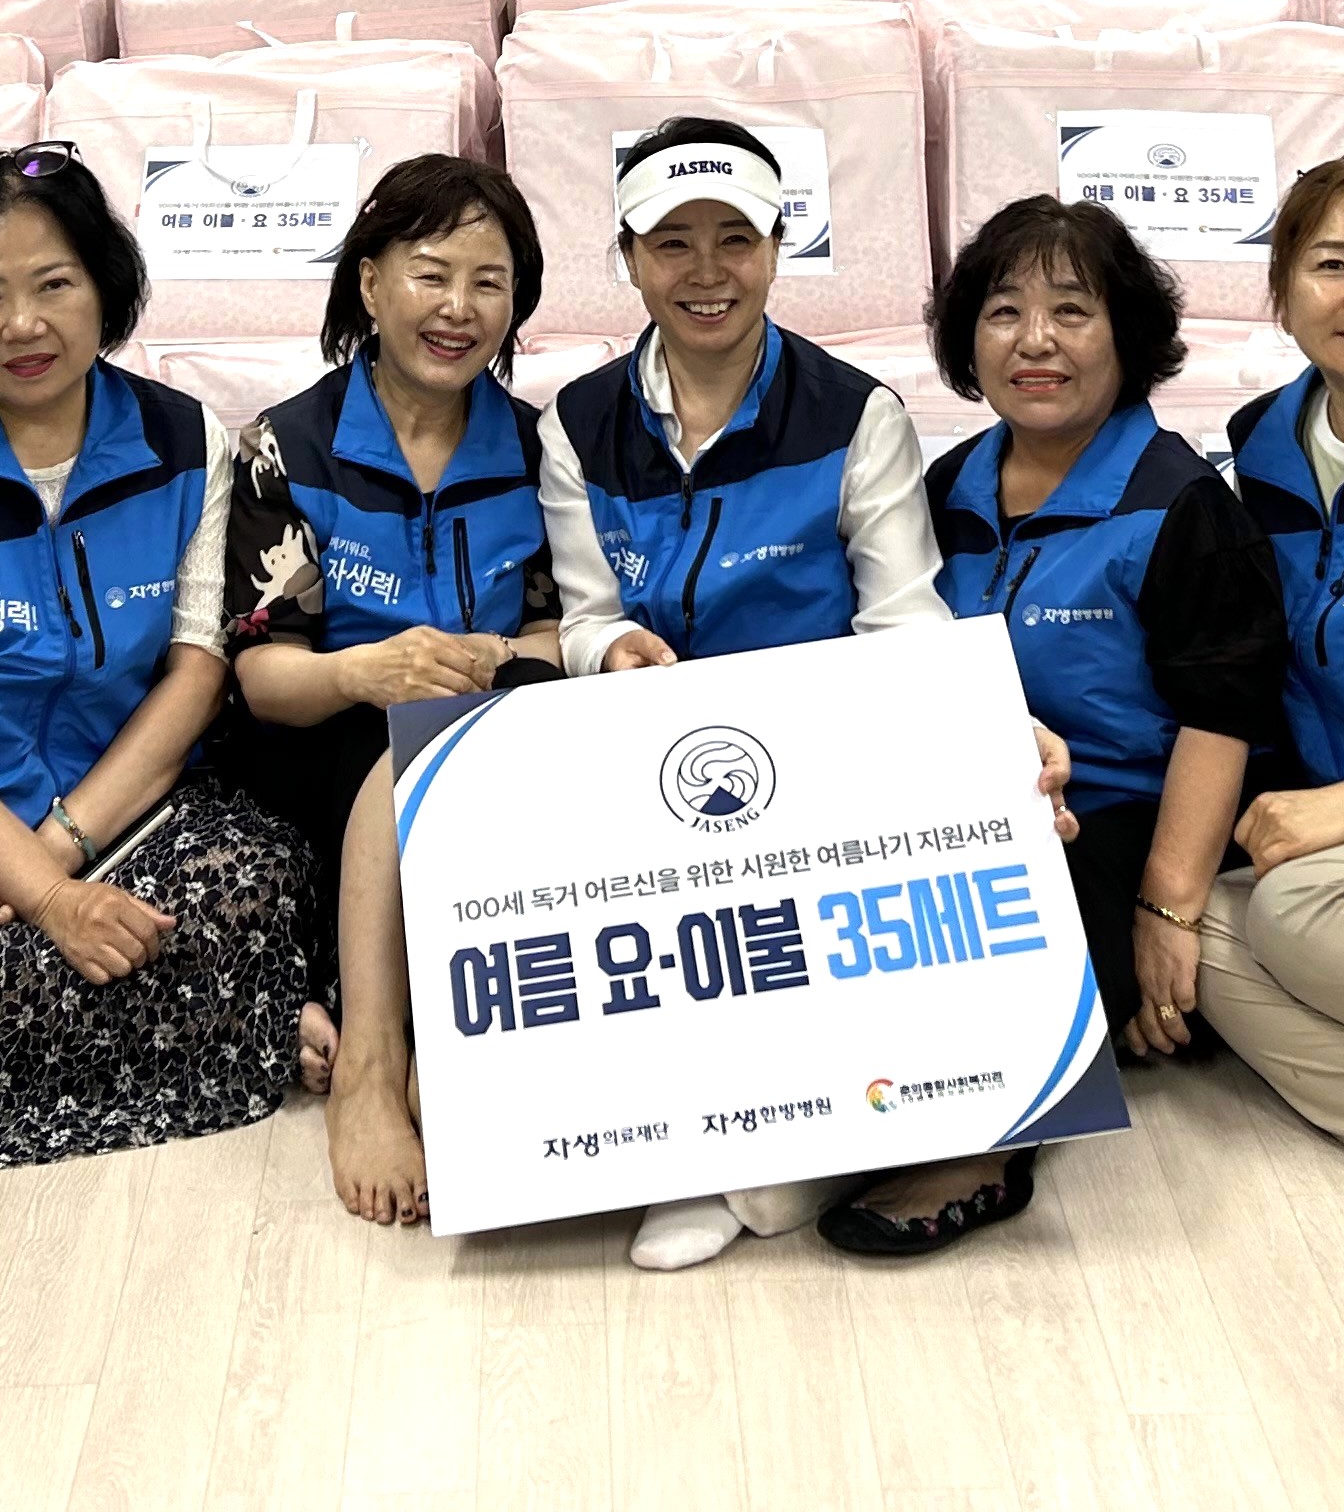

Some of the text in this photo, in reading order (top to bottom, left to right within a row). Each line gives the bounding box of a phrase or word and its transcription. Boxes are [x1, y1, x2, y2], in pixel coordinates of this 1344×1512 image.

[667, 160, 733, 179] JASENG
[327, 558, 402, 605] 자생력!
[689, 807, 760, 834] JASENG
[452, 817, 1013, 922] 100세 독거 어르신을 위한 시원한 여름나기 지원사업
[449, 930, 581, 1037] 여름
[818, 864, 1048, 982] 35세트
